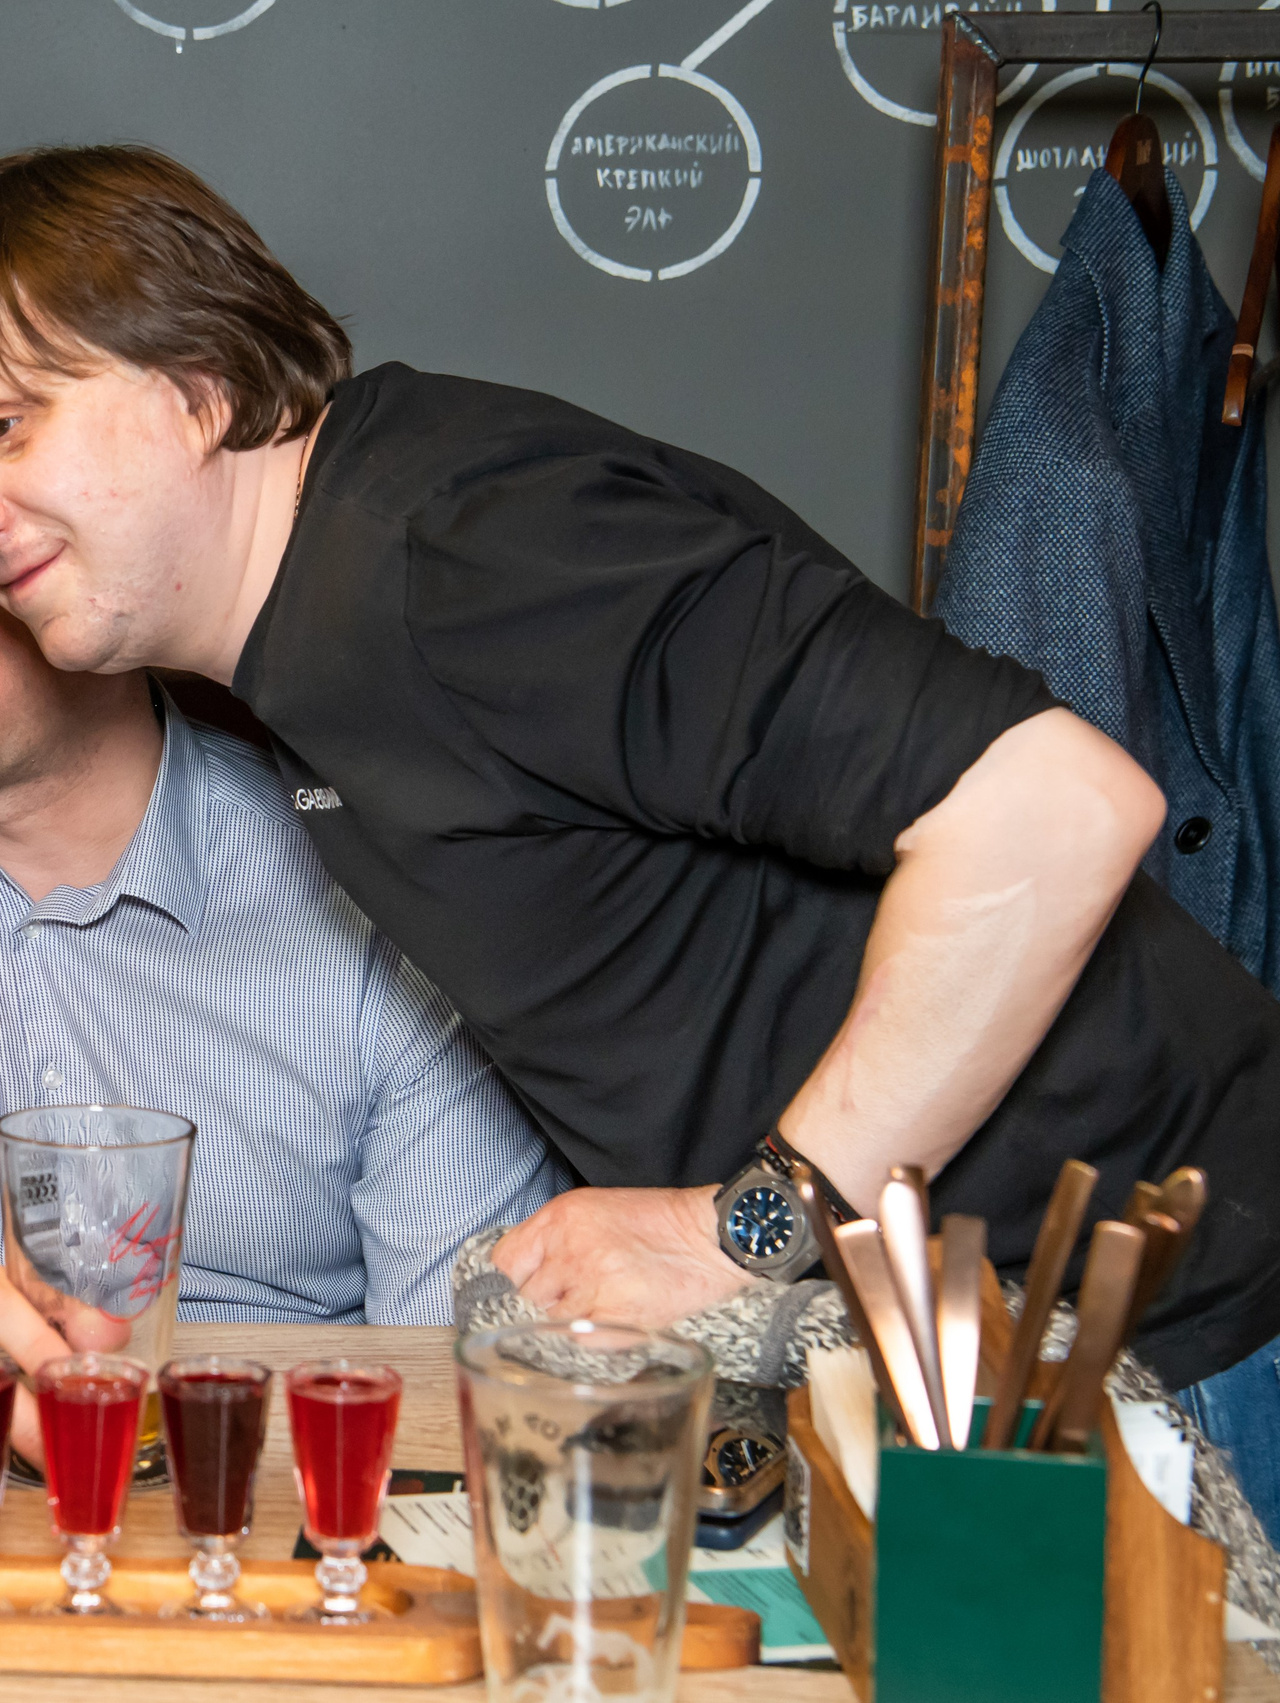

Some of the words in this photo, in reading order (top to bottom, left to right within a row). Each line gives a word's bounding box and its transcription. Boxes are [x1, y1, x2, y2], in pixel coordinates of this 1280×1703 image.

[571, 123, 739, 157] АМЕРИКАНСКИЙ
[1016, 131, 1197, 172] ШОТЛАНИЙ
[596, 160, 703, 190] КРЕПКИЙ
